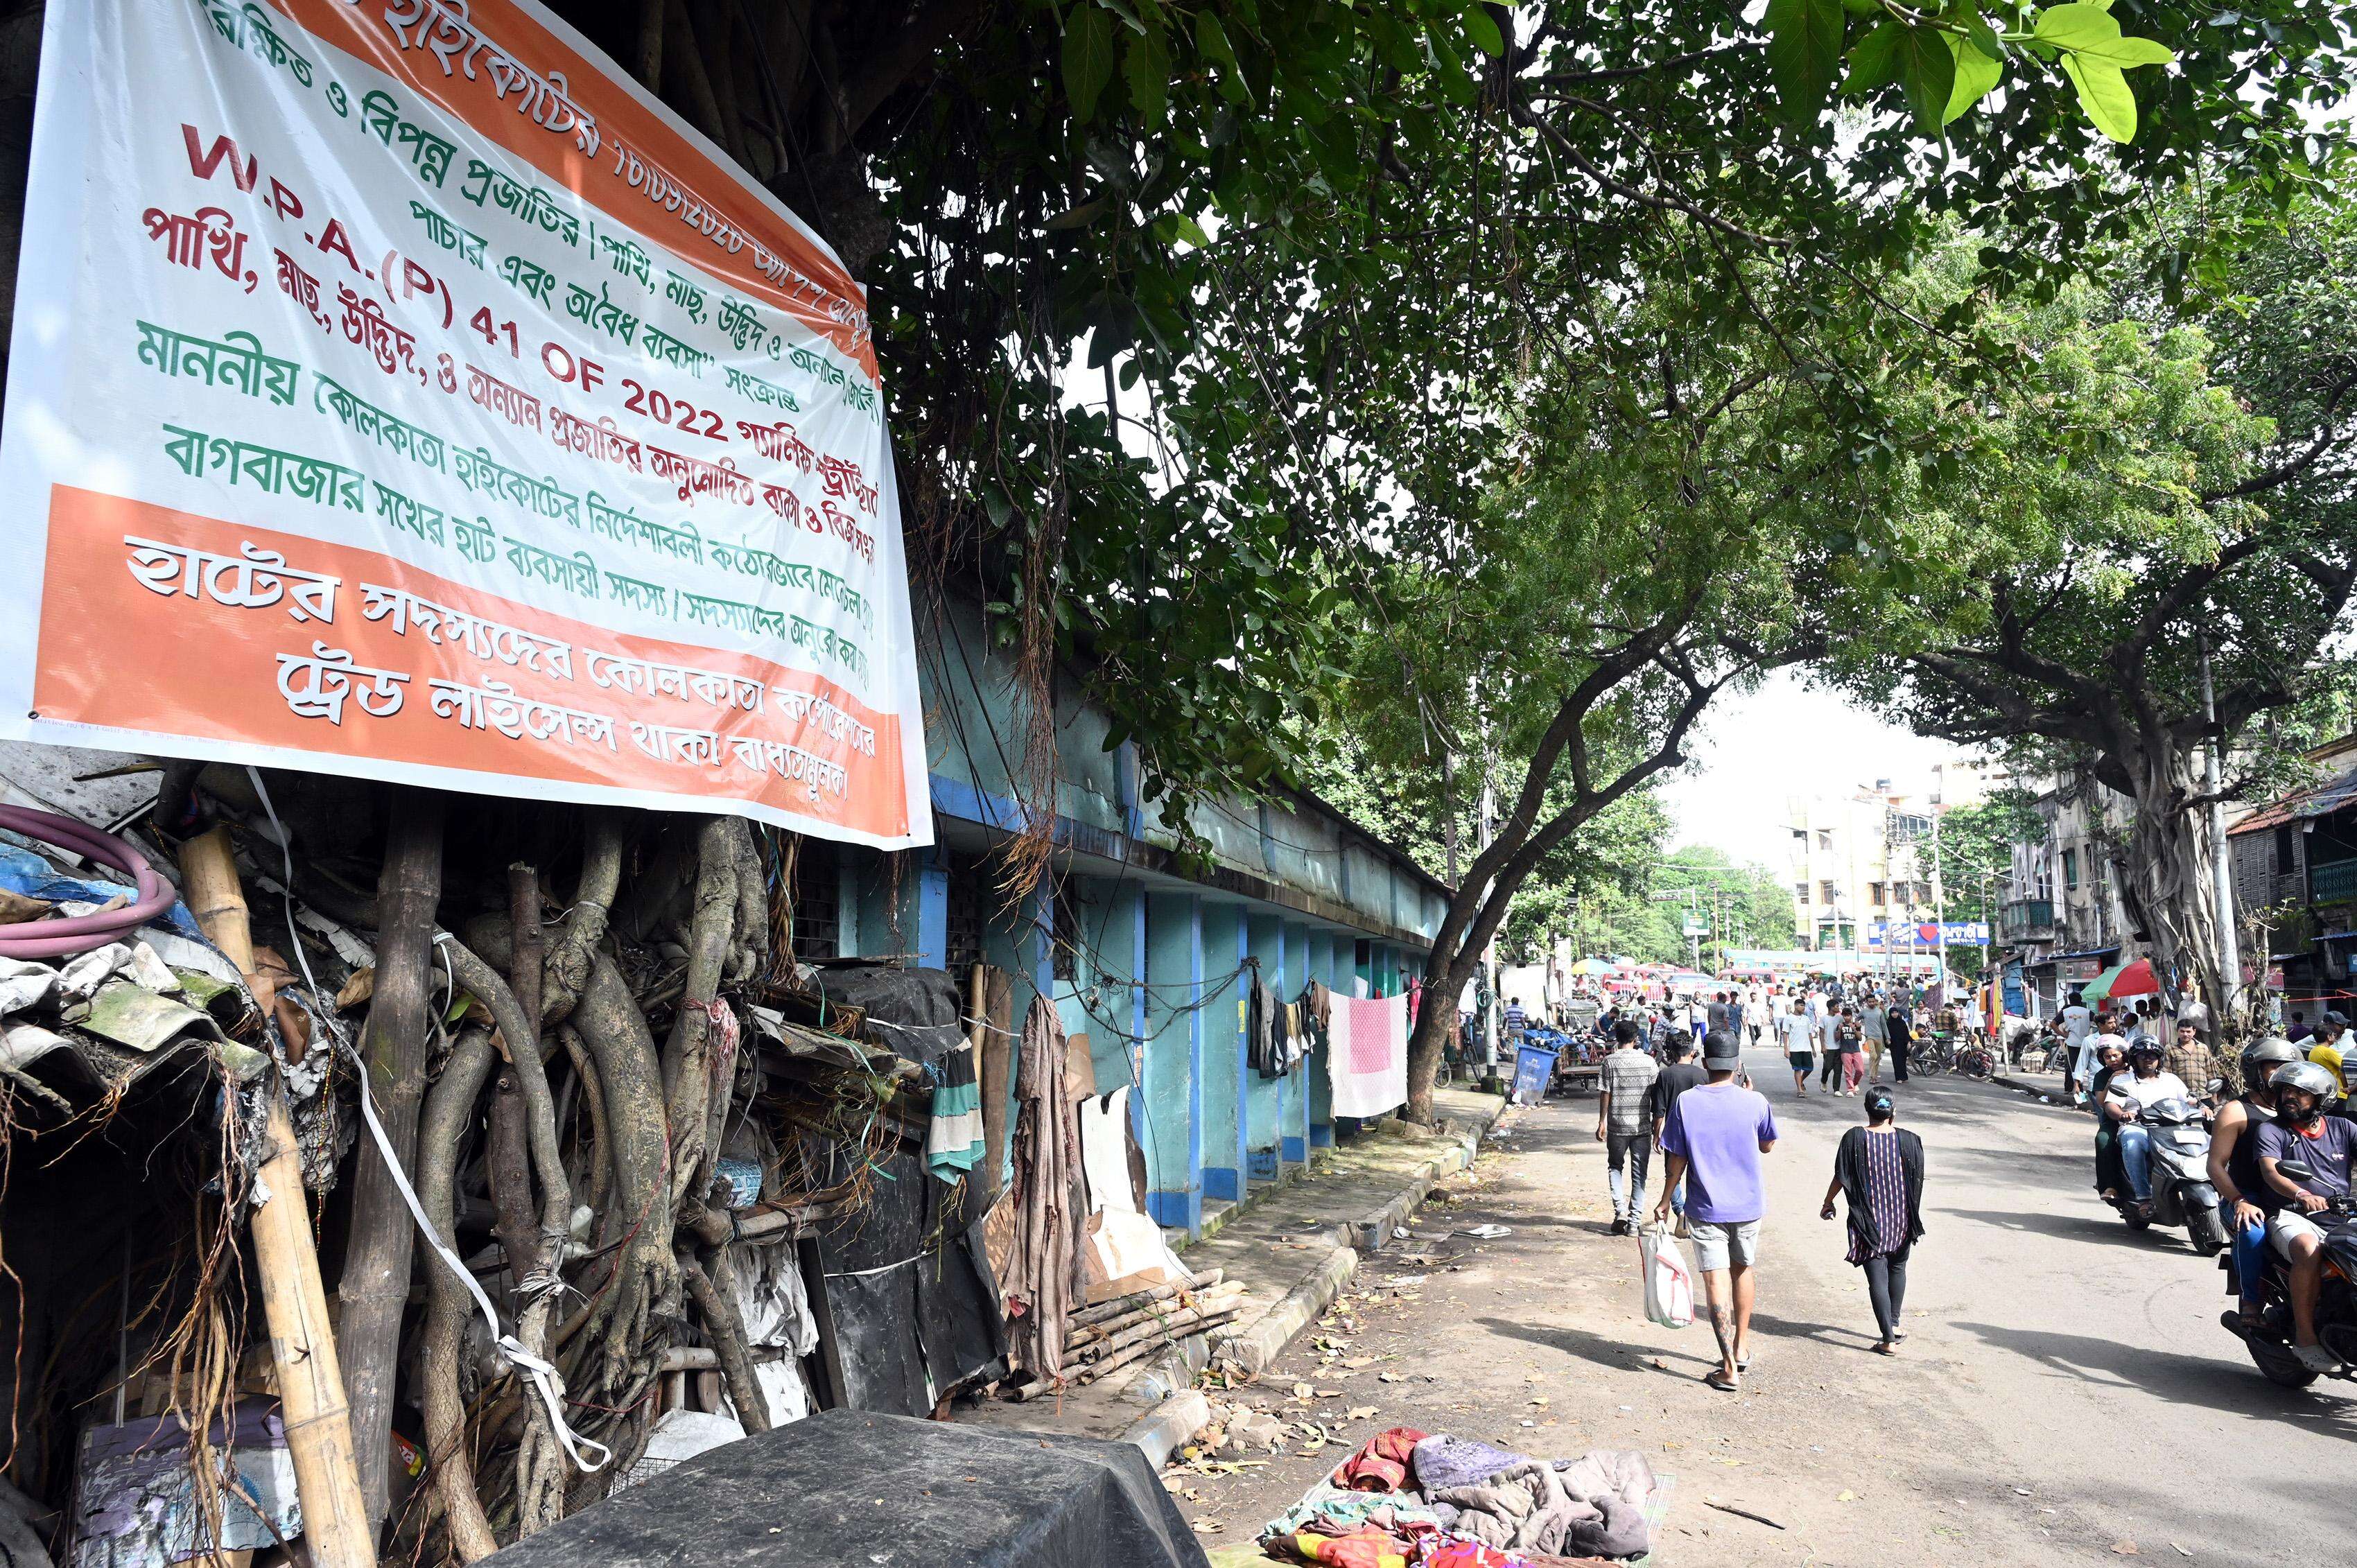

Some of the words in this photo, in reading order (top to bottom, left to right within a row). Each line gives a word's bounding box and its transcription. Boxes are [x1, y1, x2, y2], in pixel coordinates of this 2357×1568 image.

[180, 123, 453, 329] W.P.A.(P)
[470, 306, 520, 359] 41
[540, 340, 605, 393] OF
[621, 378, 729, 442] 2022
[198, 0, 313, 89] রক্ষিত
[326, 81, 347, 118] ও
[360, 89, 458, 189] বিপন্ন
[461, 159, 580, 247] প্রজাতির
[666, 269, 708, 325] মাছ,
[718, 294, 767, 351] উদ্ভিদ
[767, 335, 781, 361] ও
[141, 206, 259, 295] পাখি,
[273, 245, 333, 335] মাছ,
[337, 280, 428, 387] উদ্ভিদ,
[437, 352, 458, 394] ও
[549, 406, 643, 474] প্রজাতির
[646, 443, 754, 507] অনুমোদিত
[804, 505, 824, 534] ও
[410, 200, 487, 270] পাচার
[496, 255, 556, 311] এবং
[566, 281, 639, 347] অবৈধ
[722, 365, 800, 413] সংক্রান্ত
[135, 319, 301, 407] মাননীয়
[313, 369, 447, 475] কোলকাতা
[586, 489, 704, 566] নির্দেশাবলী
[708, 532, 815, 593] কঠোরভাবে
[162, 423, 365, 514] বাগবাজার
[372, 479, 444, 548] সখের
[451, 515, 496, 564] হাট
[502, 534, 600, 601] ব্যবসায়ী
[604, 571, 668, 617] সদস্য
[123, 534, 342, 625] হাটের
[358, 582, 575, 683] সদস্যদের
[582, 646, 766, 718] কোলকাতা
[274, 640, 410, 726] ট্রেড
[428, 674, 618, 753] লাইসেন্স
[628, 719, 721, 767] থাকা
